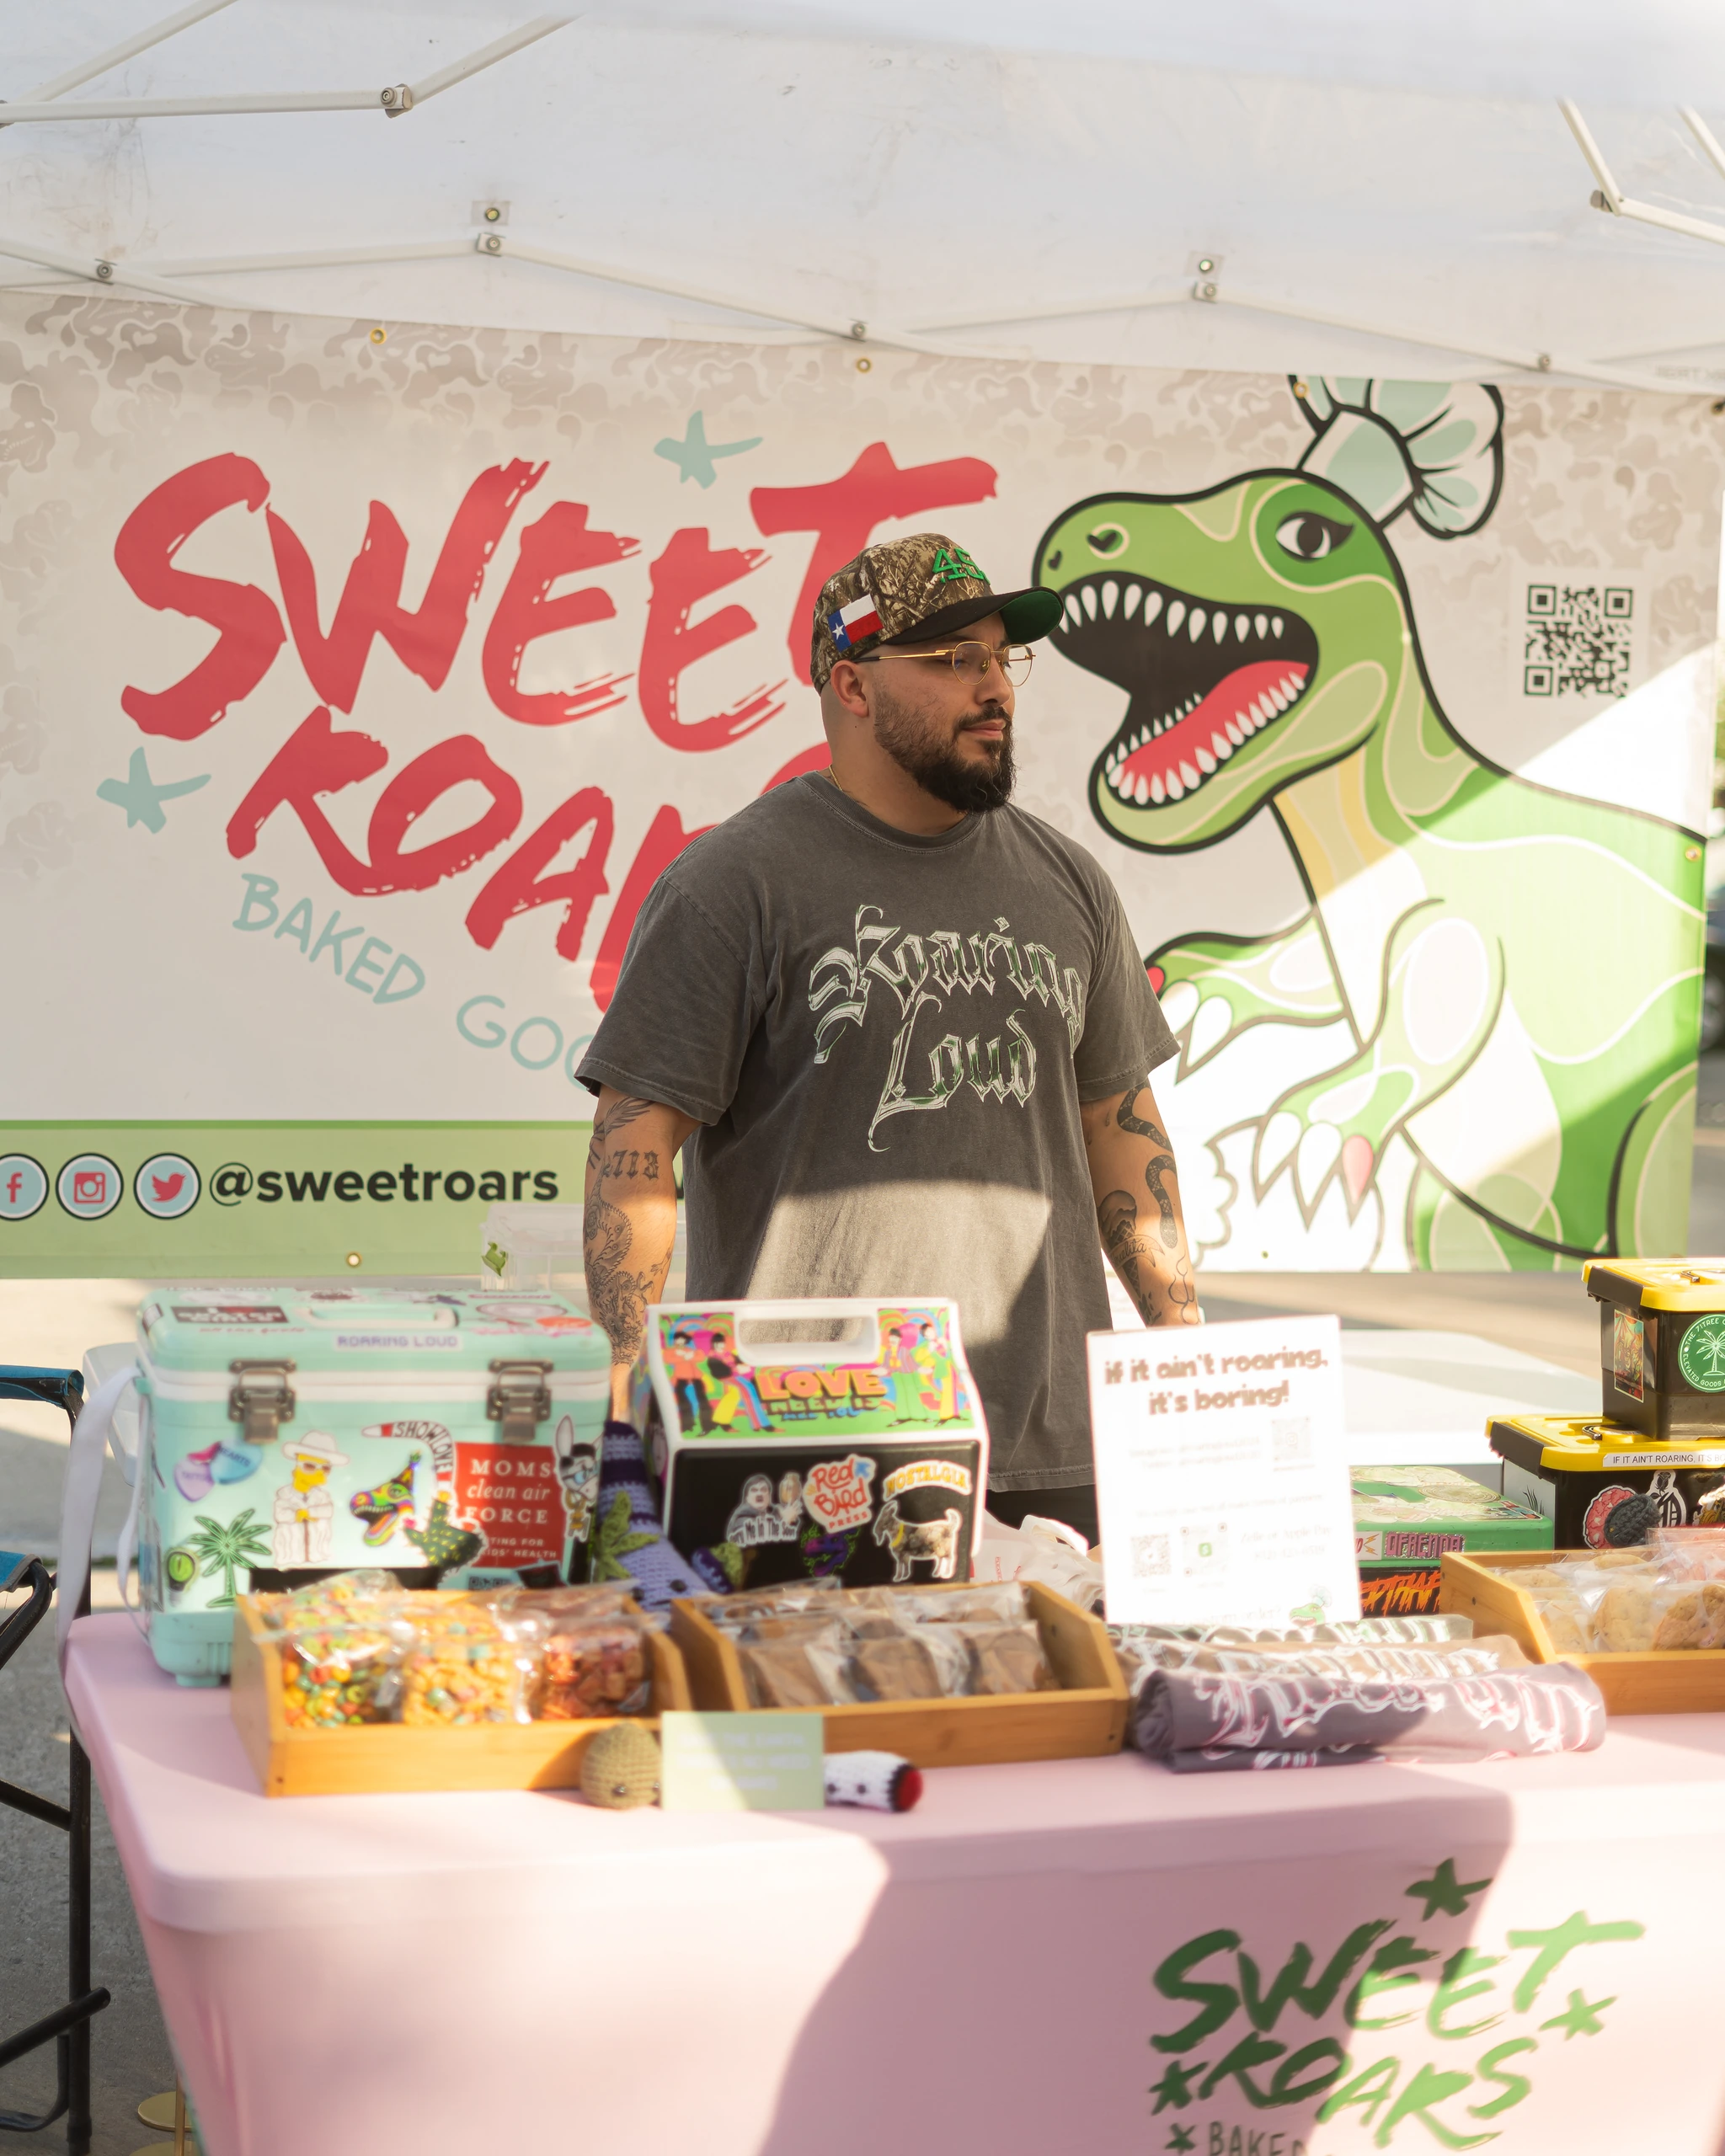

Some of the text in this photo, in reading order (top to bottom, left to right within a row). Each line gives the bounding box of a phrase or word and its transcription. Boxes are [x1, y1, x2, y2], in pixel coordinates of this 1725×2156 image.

[115, 441, 998, 752] SWEET
[226, 705, 828, 1015] ROA
[232, 873, 595, 1091] BAKED GOO
[809, 905, 1082, 1064] Roaring
[868, 991, 1037, 1151] Loud
[612, 1150, 659, 1181] 713
[209, 1161, 558, 1207] @sweetroars
[338, 1335, 458, 1347] ROARING LOUD
[1685, 1331, 1696, 1346] THE
[1104, 1345, 1328, 1385] if it ain't roaring,
[1683, 1353, 1700, 1382] ELEVATED
[757, 1369, 888, 1401] LOVE
[1149, 1380, 1290, 1416] it's boring!
[471, 1459, 553, 1478] MOMS
[812, 1459, 854, 1491] Red
[1622, 1455, 1630, 1464] IT
[1632, 1455, 1653, 1464] AIN'T
[1655, 1454, 1696, 1464] ROARING,
[467, 1478, 551, 1501] clean air
[885, 1464, 968, 1498] NOSTALGIA
[465, 1506, 548, 1524] FORCE
[829, 1512, 868, 1529] PRESS
[514, 1549, 557, 1558] HEALTH
[521, 1537, 544, 1547] FOR
[1150, 1910, 1645, 2053] SWEET
[1198, 2031, 1538, 2151] ROARS
